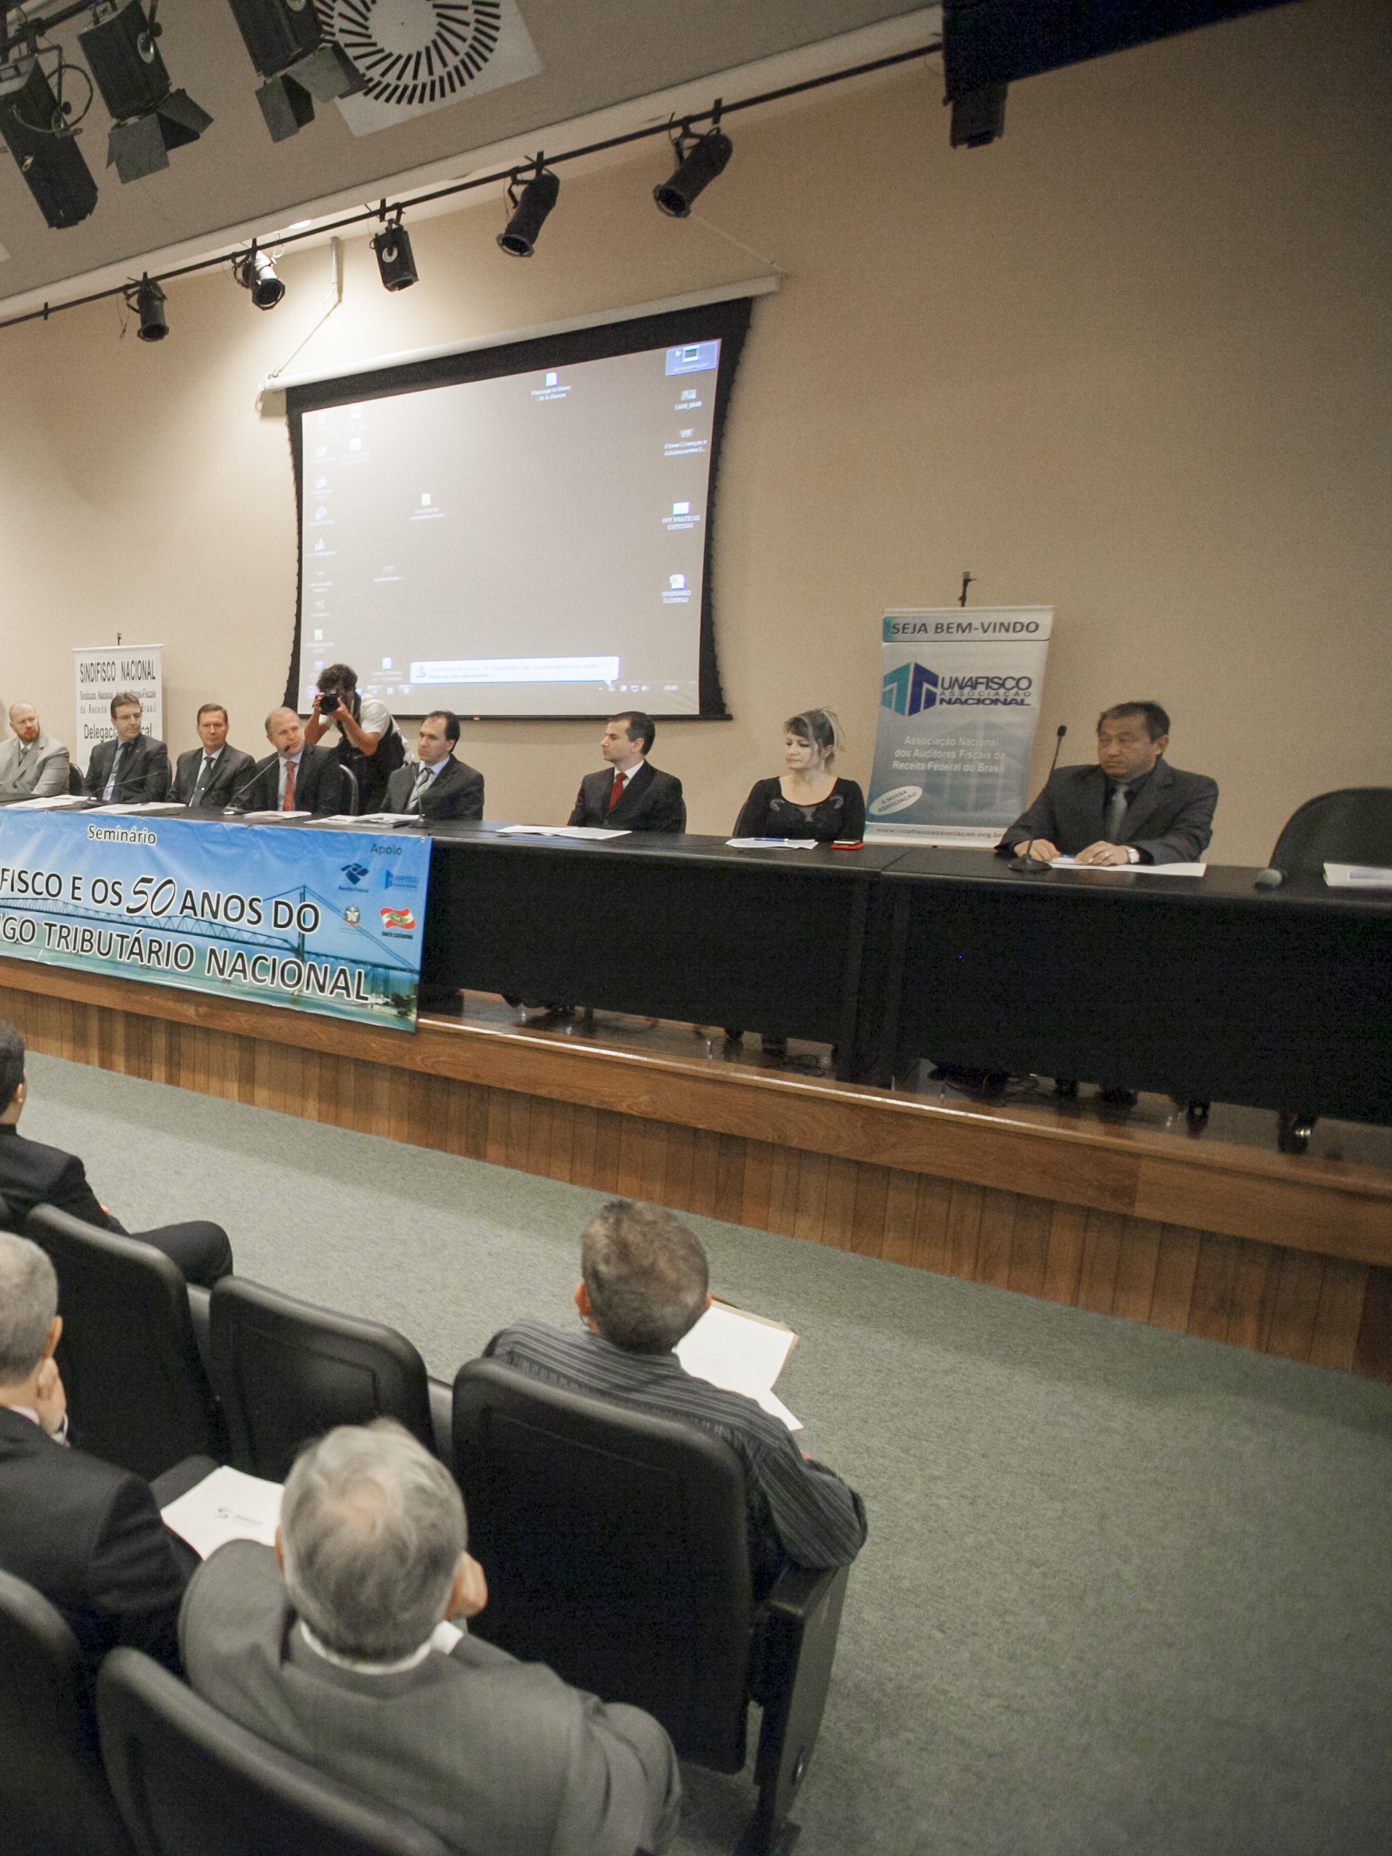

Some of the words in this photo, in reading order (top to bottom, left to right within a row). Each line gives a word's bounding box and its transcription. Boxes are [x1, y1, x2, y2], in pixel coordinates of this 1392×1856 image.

[891, 622, 929, 635] SEJA
[934, 621, 1040, 635] BEM-VINDO
[79, 661, 116, 683] SINDIFISCO
[121, 659, 156, 681] NACIONAL
[940, 676, 1032, 691] UNAFISCO
[939, 697, 1031, 707] NACIONAL
[904, 736, 957, 748] Associação
[958, 737, 1000, 747] Nacional
[894, 748, 911, 758] dos
[913, 748, 957, 759] Auditores
[959, 749, 992, 760] Fiscais
[994, 750, 1006, 760] da
[892, 760, 926, 771] Receita
[927, 761, 961, 772] Federal
[963, 762, 976, 772] do
[977, 762, 1005, 773] Brasil
[88, 824, 156, 845] Seminário
[370, 844, 403, 856] Apoio
[0, 867, 63, 898] FISCO
[71, 876, 83, 901] E
[91, 878, 123, 907] OS
[126, 876, 177, 917] 50
[179, 889, 263, 926] ANOS
[273, 899, 320, 934] DO
[43, 921, 195, 972] TRIBUTÁRIO
[205, 947, 370, 1002] NACIONAL
